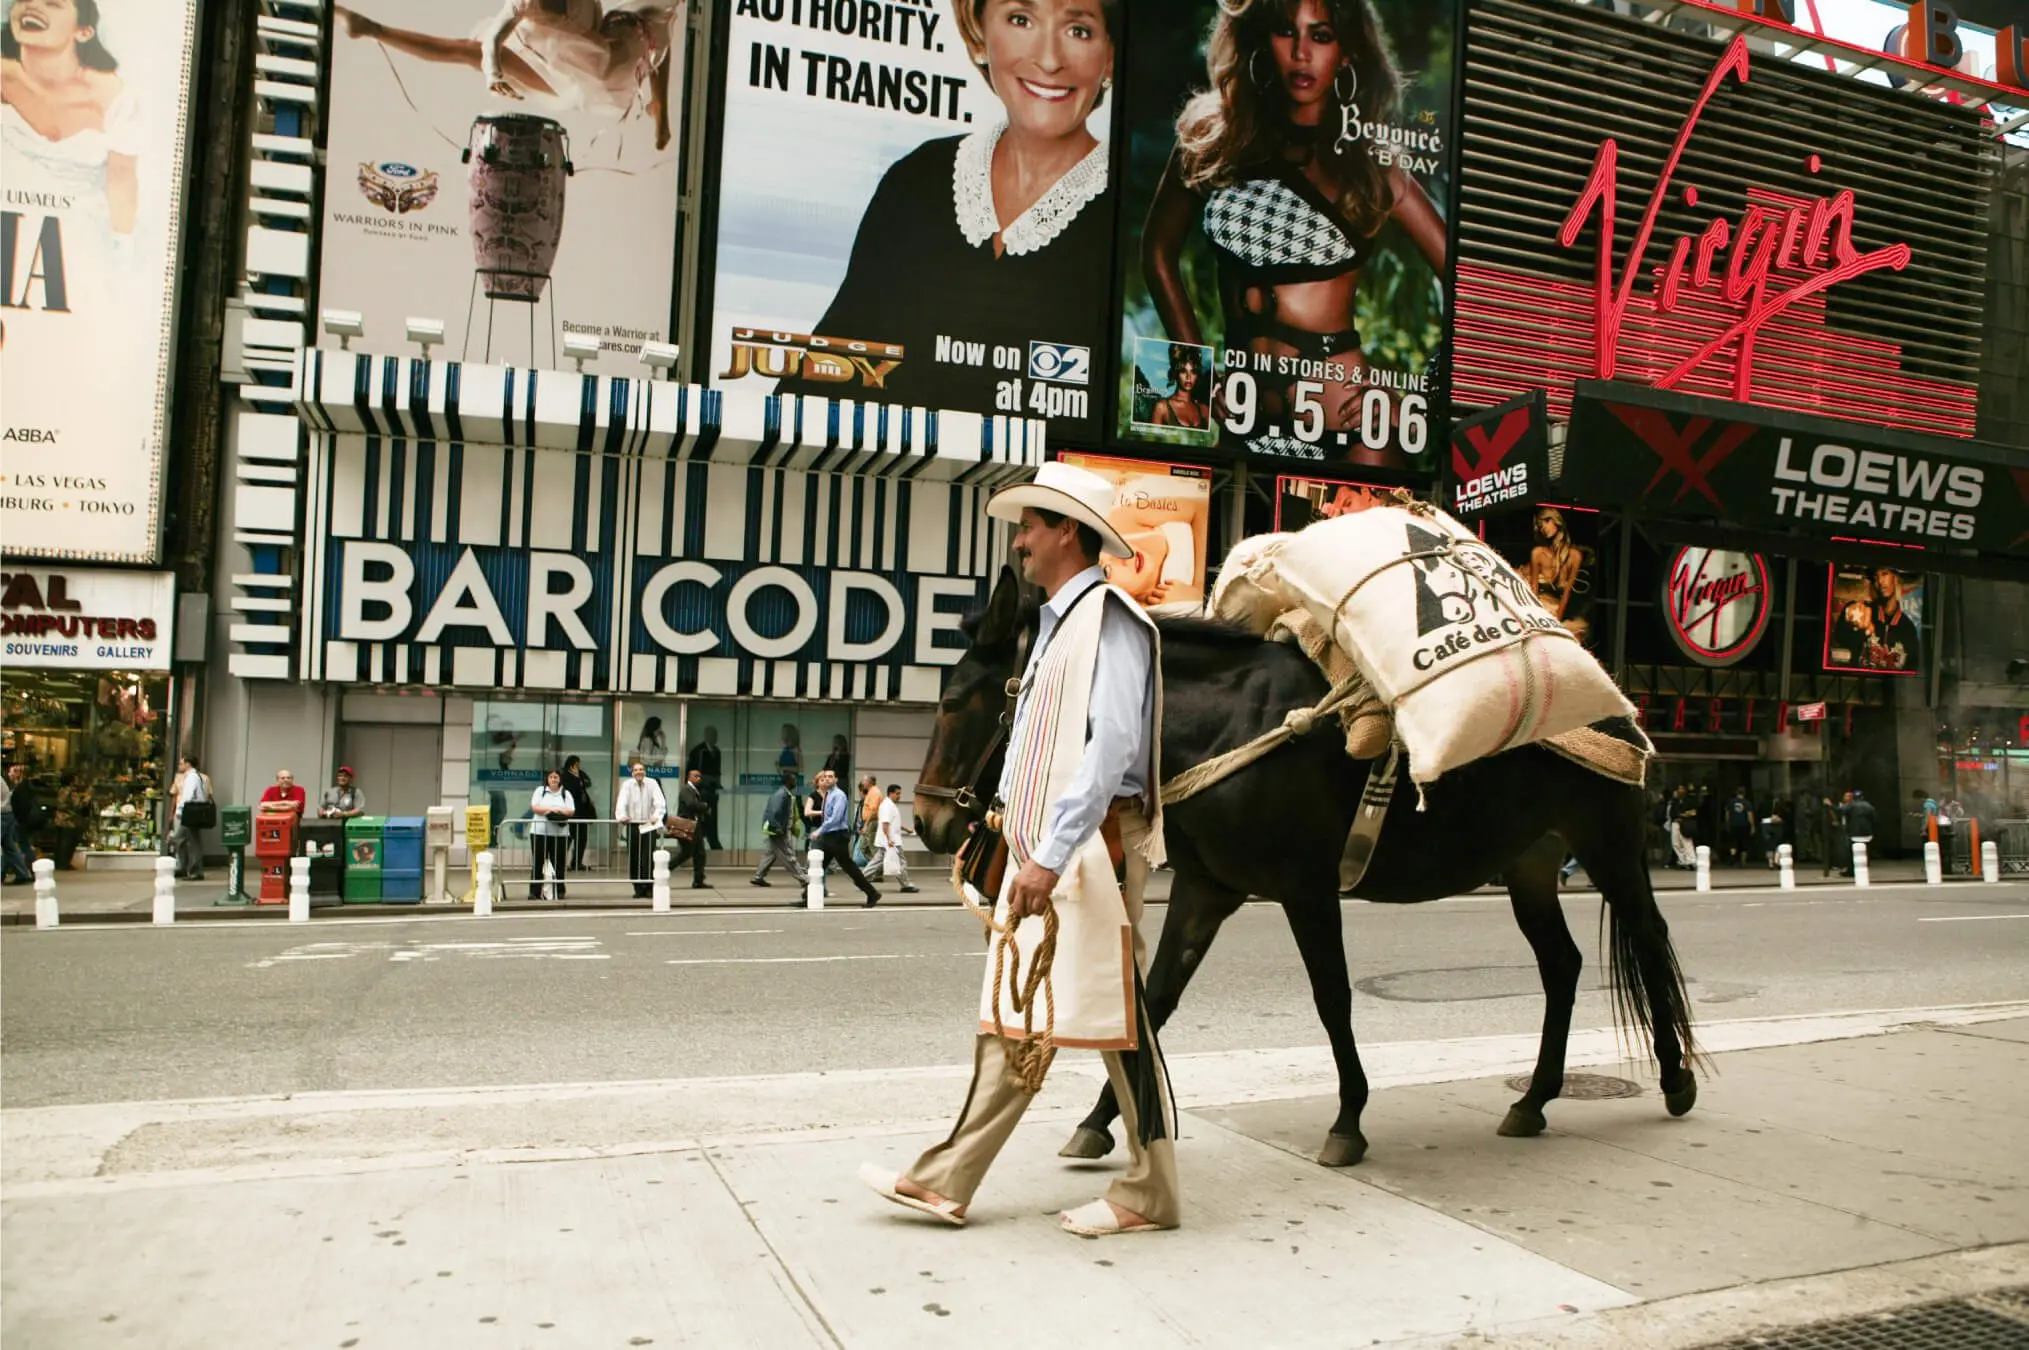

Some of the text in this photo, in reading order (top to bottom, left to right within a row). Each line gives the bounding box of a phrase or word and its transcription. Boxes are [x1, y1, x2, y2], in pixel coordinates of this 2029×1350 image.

[750, 42, 973, 123] IN TRANSIT.
[1334, 103, 1444, 155] Beyoncé
[333, 213, 459, 236] WARRIORS IN PINK
[1560, 33, 1912, 402] Virgin
[562, 320, 660, 342] Become a Warrior at
[735, 328, 902, 357] JUDGE
[719, 344, 903, 390] JUDY
[935, 334, 986, 367] Now
[993, 345, 1021, 371] on
[1224, 349, 1430, 393] CD IN STORES & ONLINE
[996, 378, 1089, 419] at 4pm
[1224, 371, 1429, 455] 9.5.06
[15, 473, 107, 491] LAS VEGAS
[1456, 462, 1528, 501] LOEWS
[1774, 437, 1985, 508] LOEWS
[79, 500, 135, 516] TOKYO
[1134, 490, 1179, 512] Basics
[1457, 482, 1529, 514] THEATRES
[1771, 487, 1977, 541] THEATRES
[340, 540, 598, 649] BAR
[641, 560, 977, 665] CODE
[1673, 548, 1764, 649] Virgin
[6, 642, 154, 659] SOUVENIRS GALLERY
[1413, 630, 1471, 671] Café
[1473, 624, 1502, 644] de
[626, 765, 674, 775] VNADO
